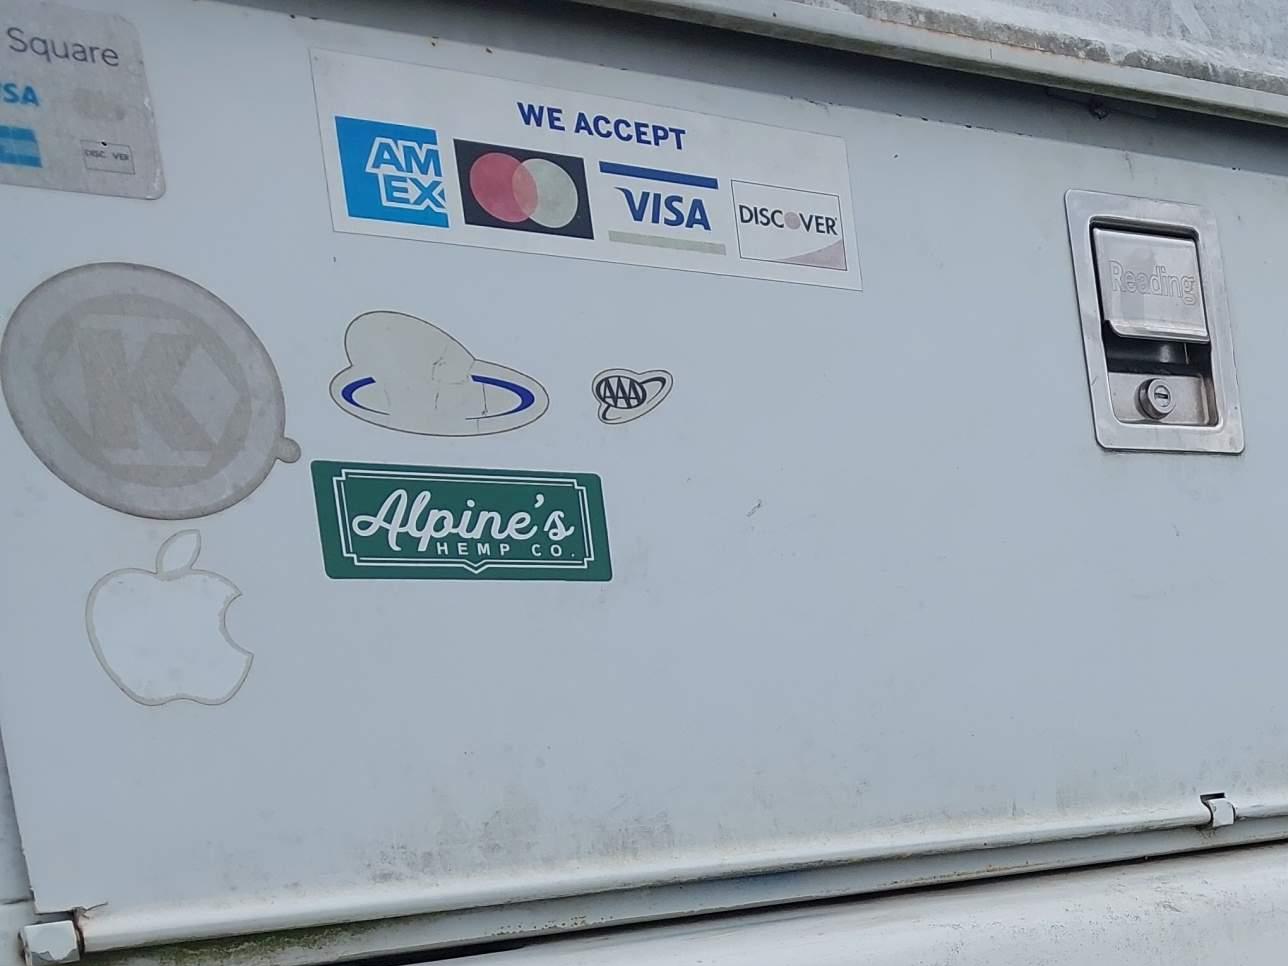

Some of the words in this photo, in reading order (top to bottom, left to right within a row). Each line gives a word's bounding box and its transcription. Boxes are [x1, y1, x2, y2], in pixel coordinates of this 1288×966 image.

[7, 26, 120, 67] Square
[0, 82, 40, 107] SA
[516, 101, 566, 132] WE
[574, 112, 686, 151] ACCEPT
[367, 139, 443, 178] AM
[382, 173, 447, 210] EX
[614, 186, 711, 231] VISA
[1108, 260, 1197, 305] Reading
[599, 375, 645, 409] AAA
[352, 488, 576, 552] Alpine's
[436, 542, 511, 556] HEMP
[531, 543, 576, 558] CO.
